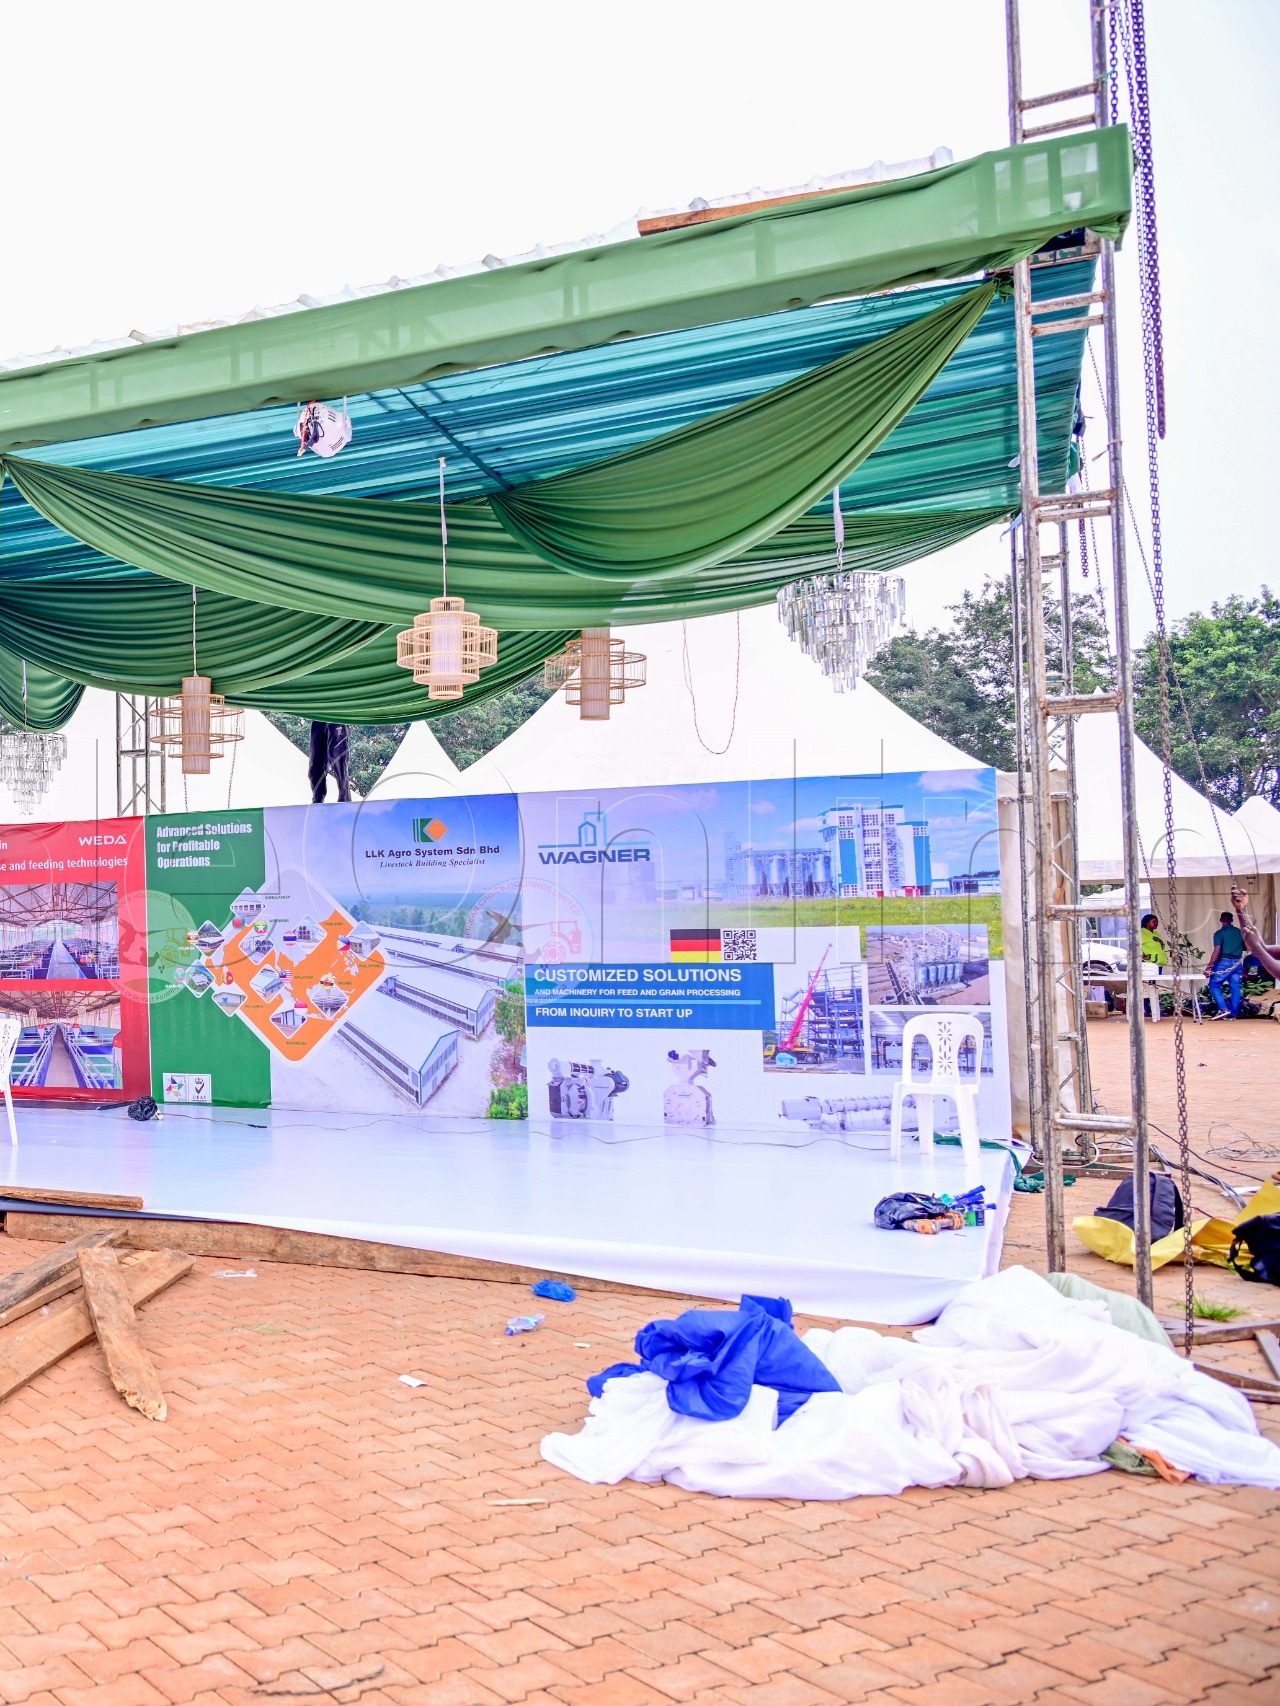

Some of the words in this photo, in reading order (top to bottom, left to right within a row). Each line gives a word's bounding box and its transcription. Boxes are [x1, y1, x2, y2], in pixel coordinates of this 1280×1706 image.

[156, 824, 204, 838] Advanced
[204, 822, 253, 835] Solutions
[78, 835, 126, 846] WEDA
[156, 841, 171, 853] for
[172, 839, 220, 852] Profitable
[365, 850, 385, 858] LLK
[387, 849, 412, 859] Agro
[414, 847, 453, 857] System
[456, 846, 476, 855] Sdn
[479, 845, 500, 854] Bhd
[538, 848, 651, 865] WAGNER
[9, 860, 26, 871] and
[29, 858, 64, 871] feeding
[67, 856, 128, 869] technologies
[157, 855, 210, 869] Operations
[380, 860, 413, 868] Livestock
[415, 859, 447, 868] Building
[448, 857, 486, 867] Specialist
[534, 968, 639, 982] CUSTOMIZED
[642, 968, 742, 982] SOLUTIONS
[534, 988, 551, 996] AND
[552, 988, 597, 996] MACHINERY
[599, 988, 616, 996] FOR
[617, 988, 637, 996] FEED
[639, 988, 657, 996] AND
[658, 988, 686, 996] GRAIN
[687, 988, 741, 997] PROCESSING
[535, 1008, 567, 1017] FROM
[570, 1008, 616, 1017] INQUIRY
[617, 1008, 634, 1017] TO
[635, 1008, 673, 1018] START
[676, 1009, 693, 1018] UP
